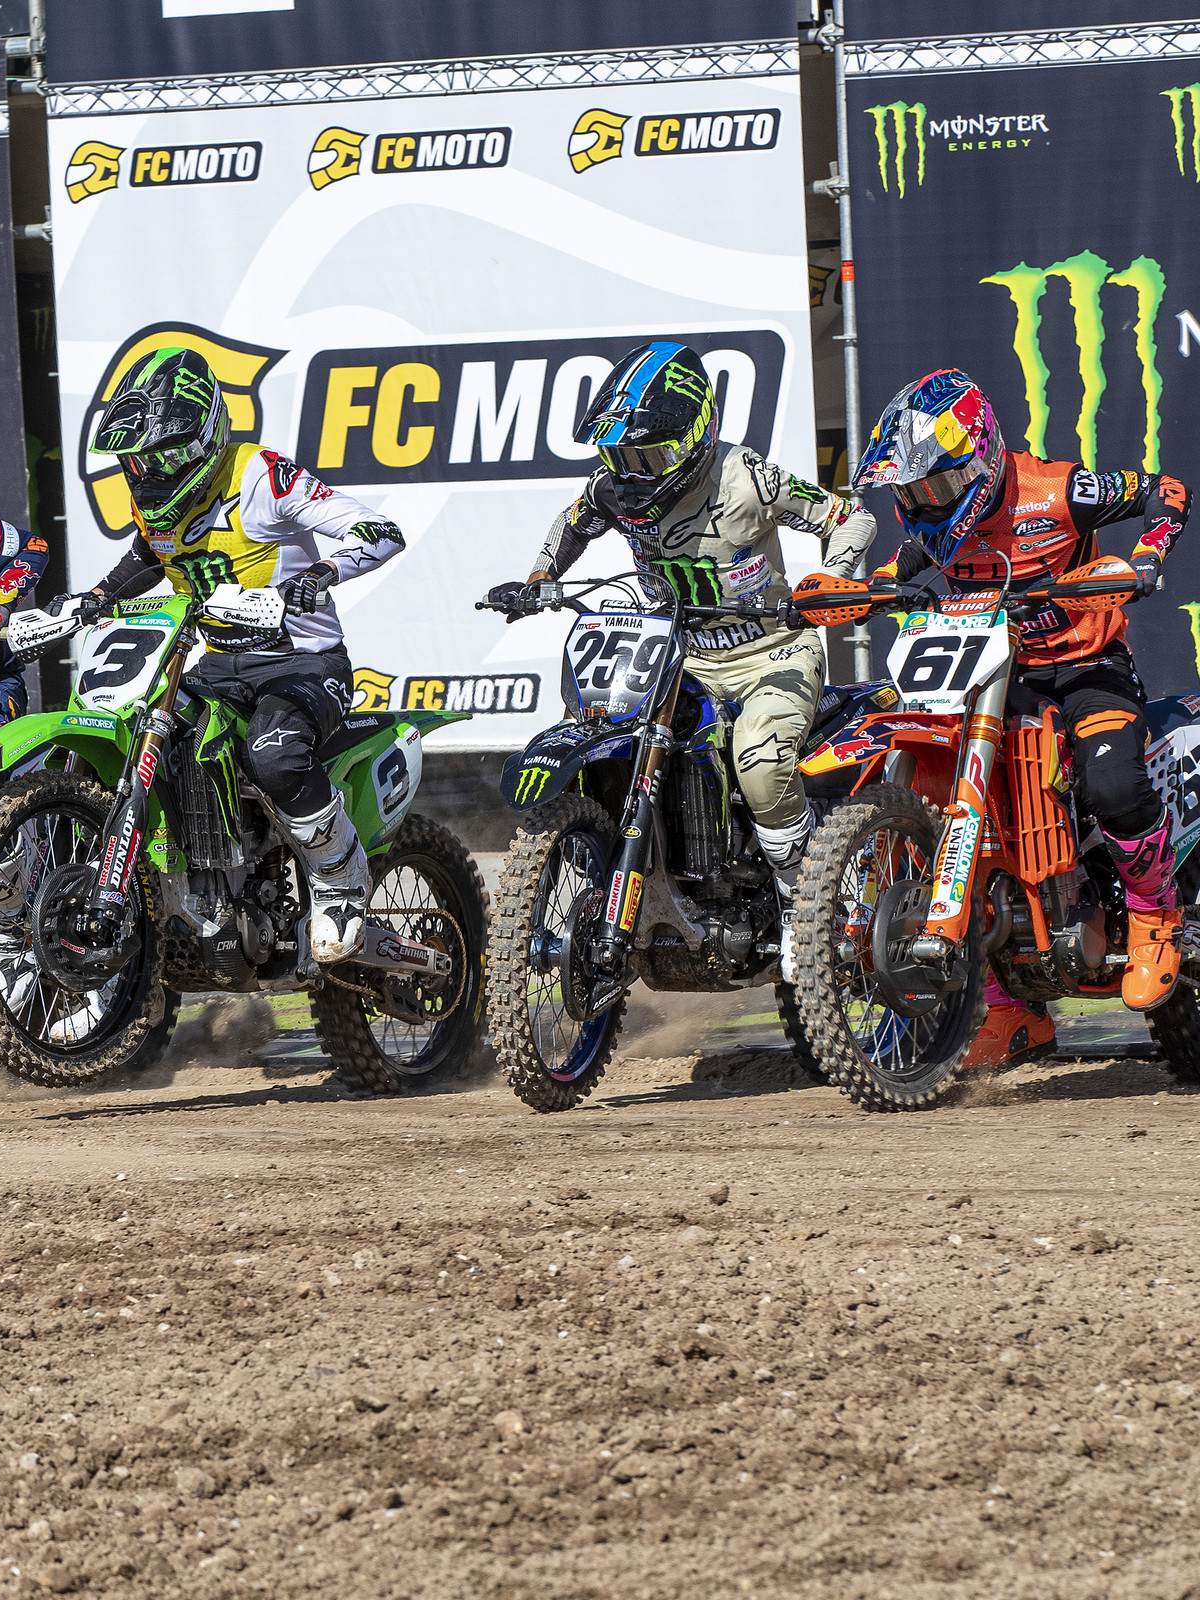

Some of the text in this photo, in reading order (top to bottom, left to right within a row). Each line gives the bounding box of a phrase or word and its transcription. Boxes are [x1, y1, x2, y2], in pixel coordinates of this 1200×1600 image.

[929, 113, 1050, 139] MONSTER
[948, 138, 1032, 152] ENERGY
[449, 348, 757, 465] MOO
[908, 452, 924, 477] AIROH
[951, 499, 984, 540] Red
[738, 556, 767, 578] YAMAHA
[797, 578, 822, 593] KTM
[139, 618, 172, 626] MOTOREX
[223, 611, 261, 626] Polisport
[577, 622, 601, 631] MXGP
[605, 617, 643, 629] YAMAHA
[15, 626, 63, 648] Polisport
[685, 622, 766, 650] AMAHA
[899, 627, 928, 639] MXGP
[79, 628, 166, 696] 3
[573, 630, 670, 693] 259
[897, 635, 991, 693] 61
[818, 691, 841, 714] YAMAHA
[78, 718, 116, 730] MOTOREX
[345, 716, 379, 731] Kawasaki
[523, 755, 561, 768] YAMAHA
[377, 748, 410, 815] 3
[110, 808, 137, 889] DUNLOP
[943, 826, 964, 876] ATHENA
[955, 814, 981, 882] MOTOREX
[99, 836, 117, 887] BRAKING
[608, 872, 623, 922] BRAKING
[217, 939, 237, 951] CRM
